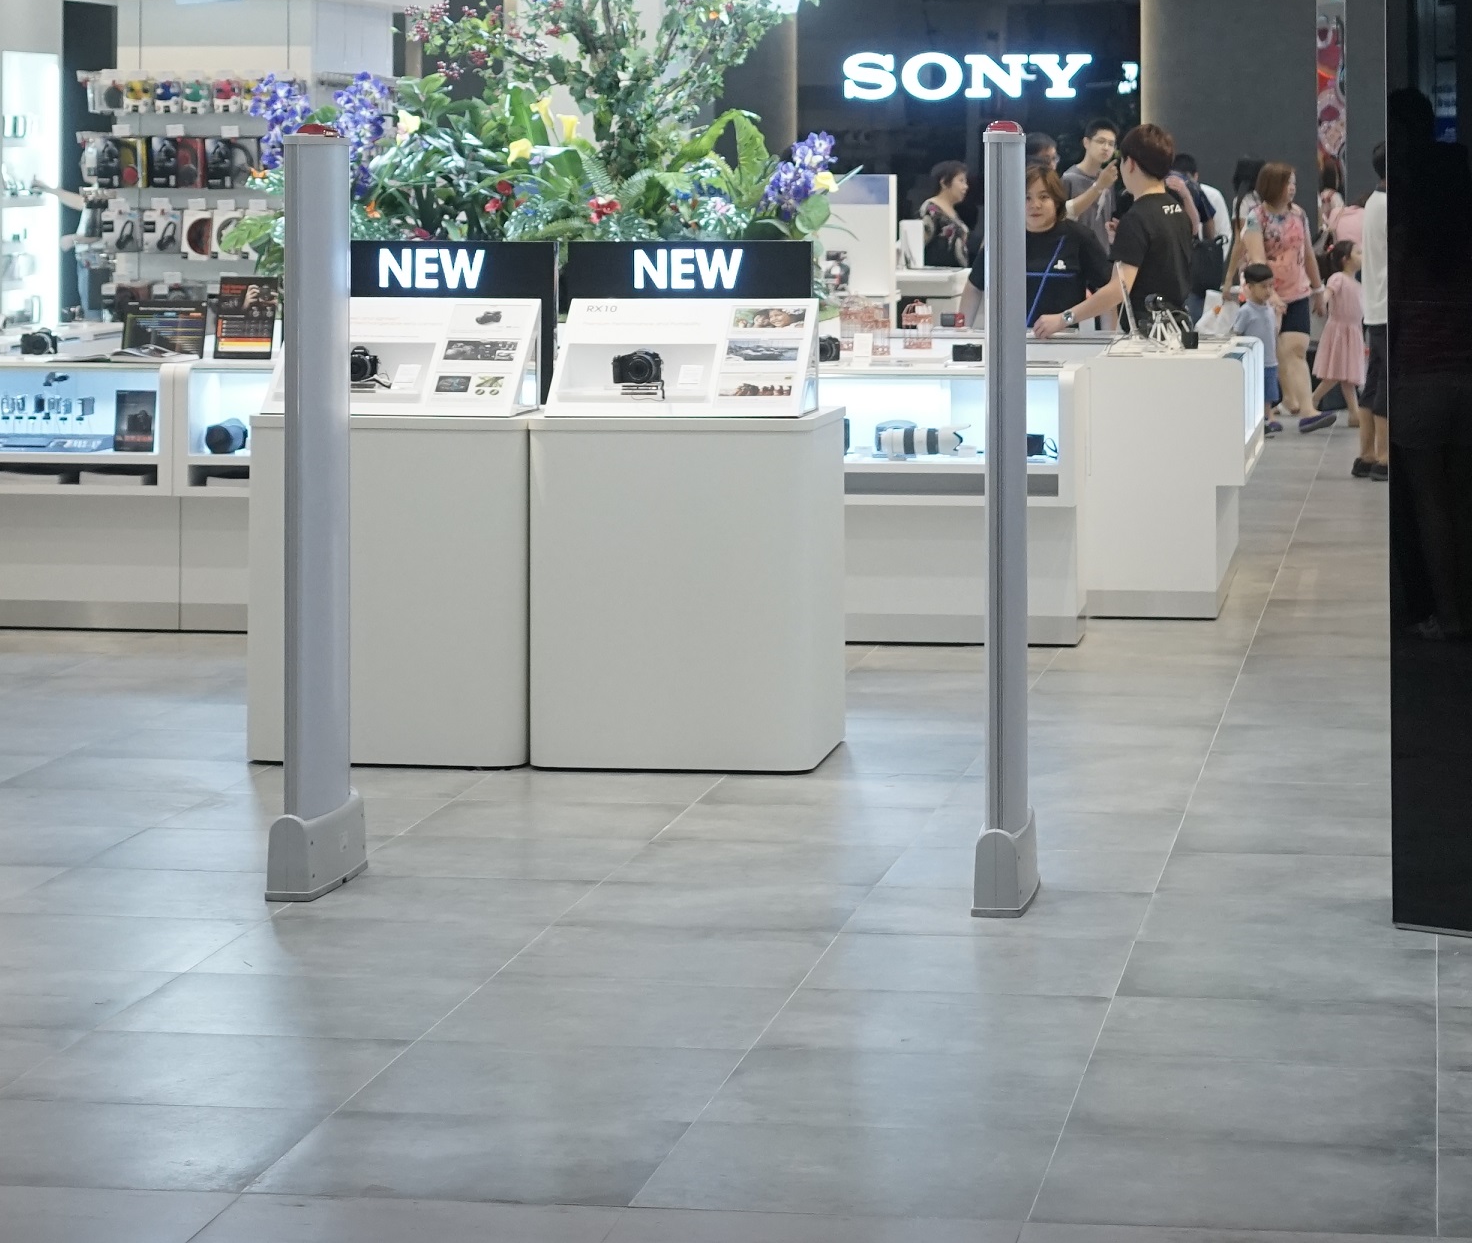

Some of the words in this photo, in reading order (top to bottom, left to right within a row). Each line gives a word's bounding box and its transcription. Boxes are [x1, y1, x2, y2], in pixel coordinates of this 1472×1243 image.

[842, 51, 1093, 101] SONY
[1161, 203, 1183, 215] PS4
[378, 248, 485, 289] NEW
[633, 248, 743, 290] NEW
[585, 305, 618, 313] RX10
